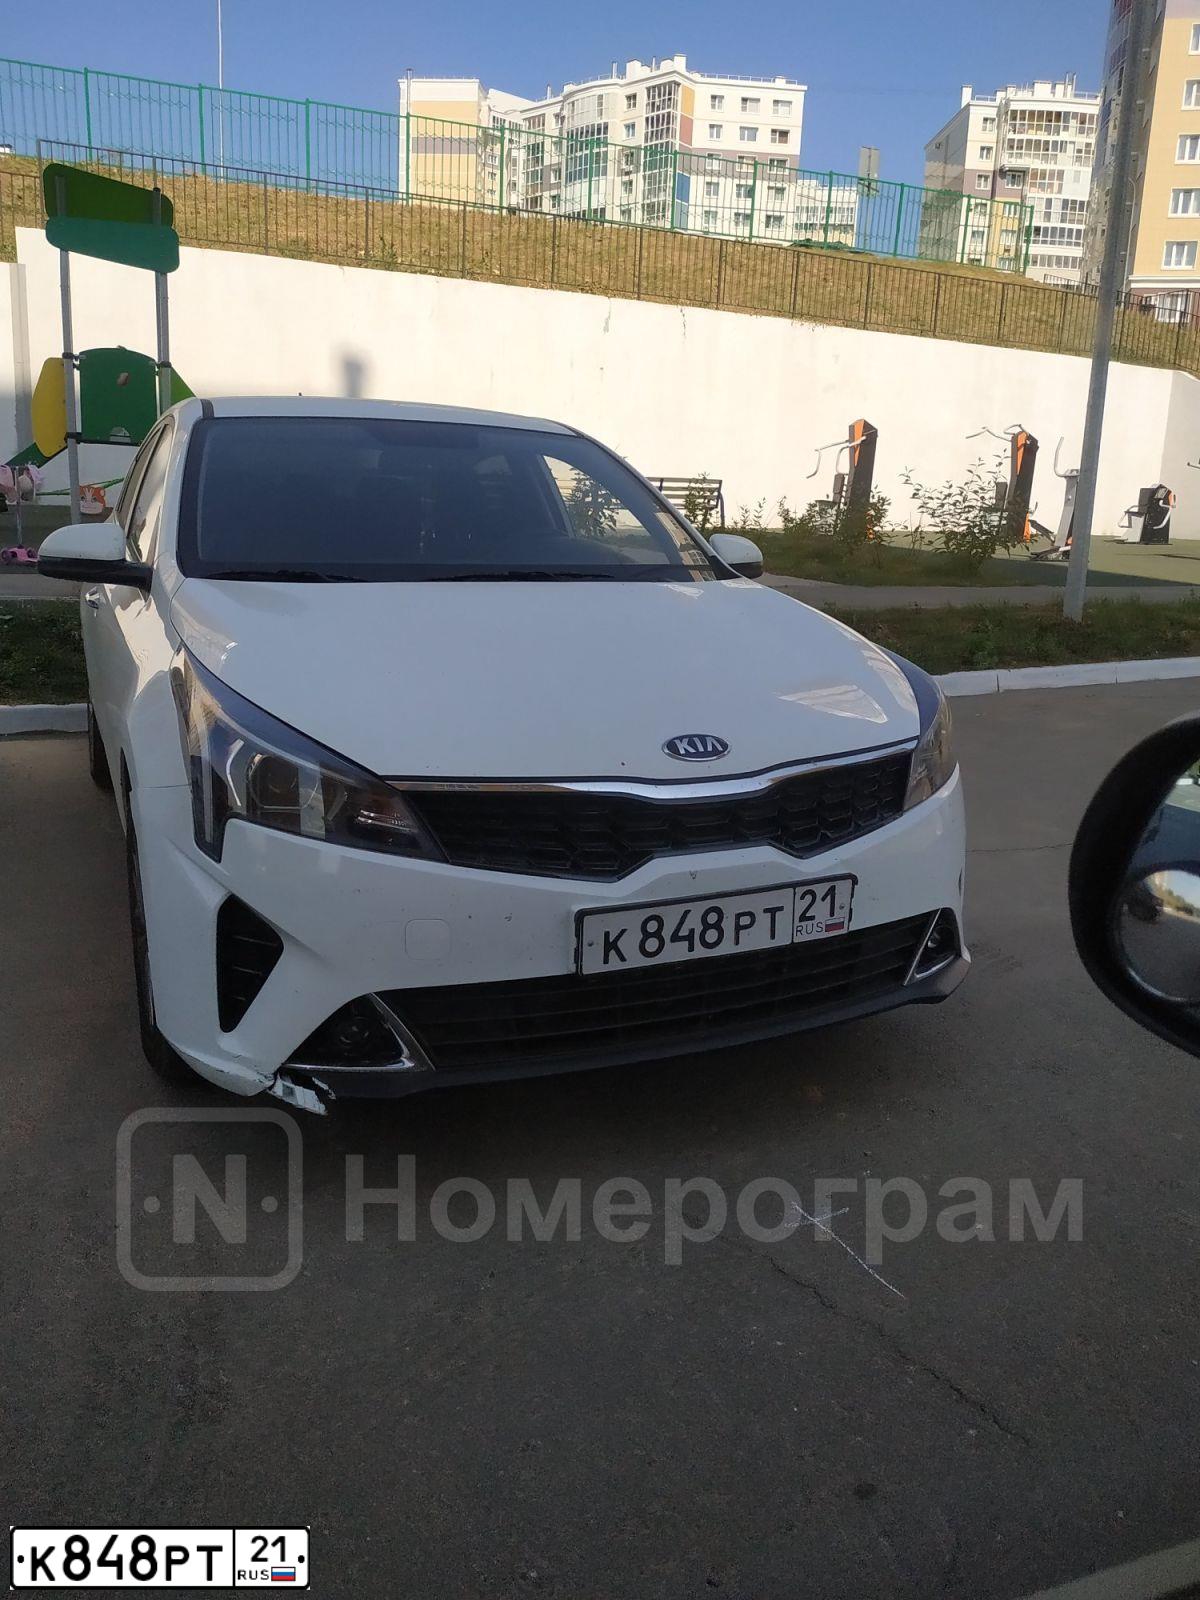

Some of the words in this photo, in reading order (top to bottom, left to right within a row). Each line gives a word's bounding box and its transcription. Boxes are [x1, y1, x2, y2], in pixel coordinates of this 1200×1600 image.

[673, 736, 723, 755] KIA
[798, 884, 837, 923] 21
[795, 921, 824, 937] RUS
